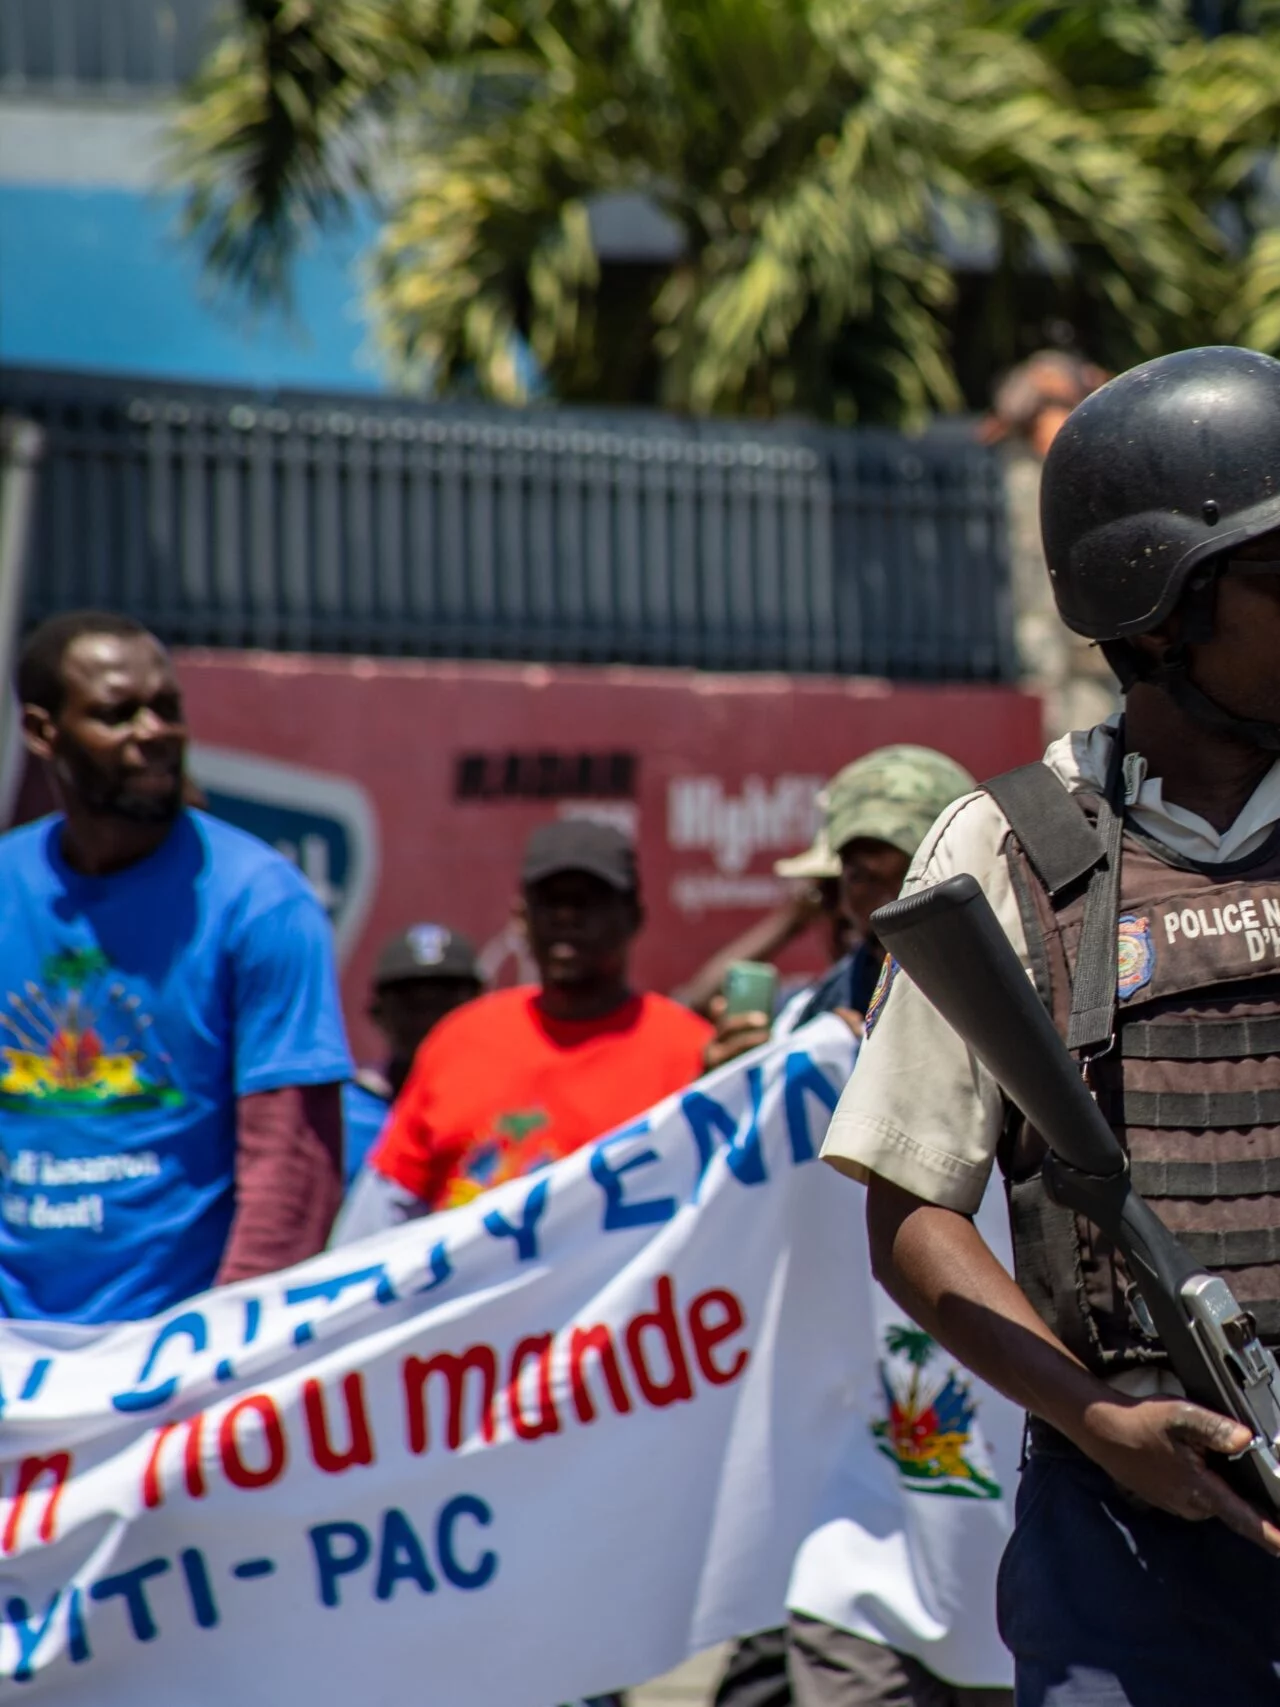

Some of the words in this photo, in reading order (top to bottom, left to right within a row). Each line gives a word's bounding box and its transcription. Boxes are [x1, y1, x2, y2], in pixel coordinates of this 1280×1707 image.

[1163, 899, 1261, 944] POLICE
[142, 1365, 376, 1511] nou
[401, 1272, 751, 1458] mande
[308, 1494, 498, 1608] PAC
